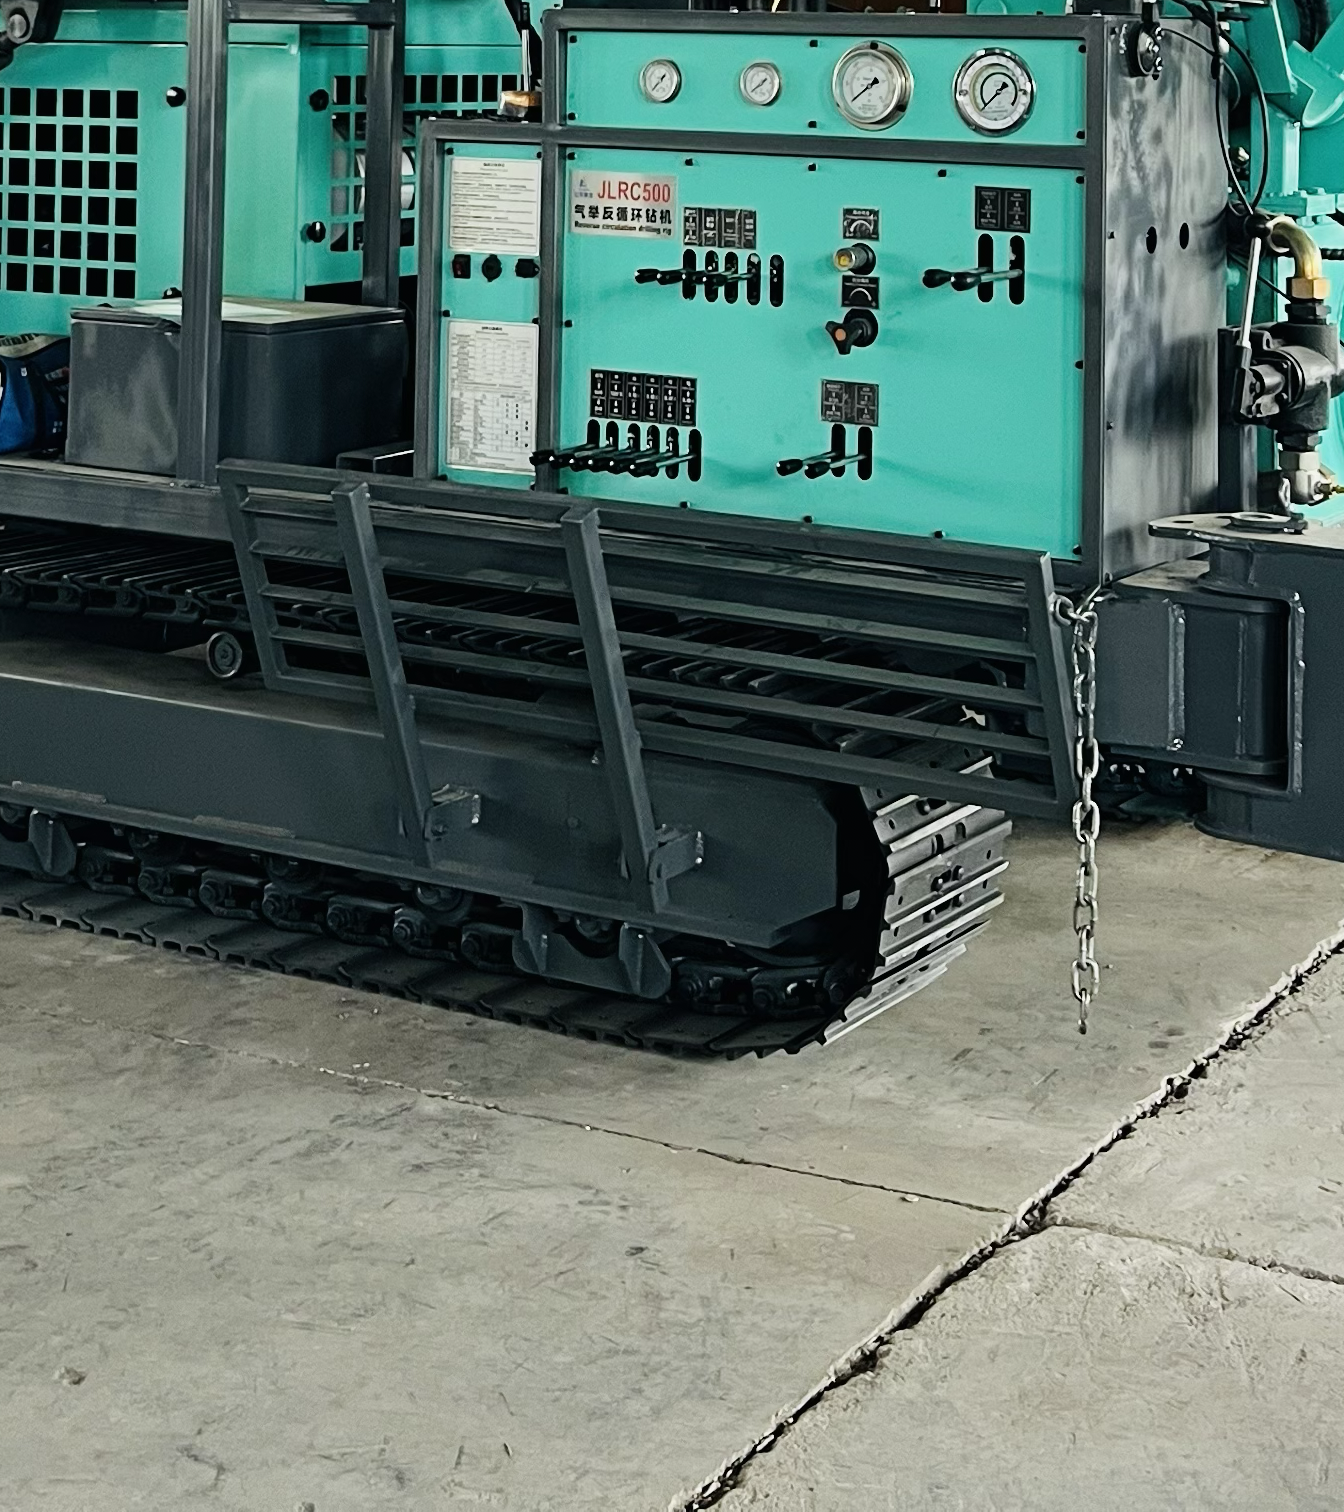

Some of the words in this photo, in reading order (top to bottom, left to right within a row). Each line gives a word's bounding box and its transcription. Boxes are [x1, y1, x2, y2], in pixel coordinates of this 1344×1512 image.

[597, 180, 671, 203] JLRC500
[574, 204, 672, 224] 气举反循环钻机
